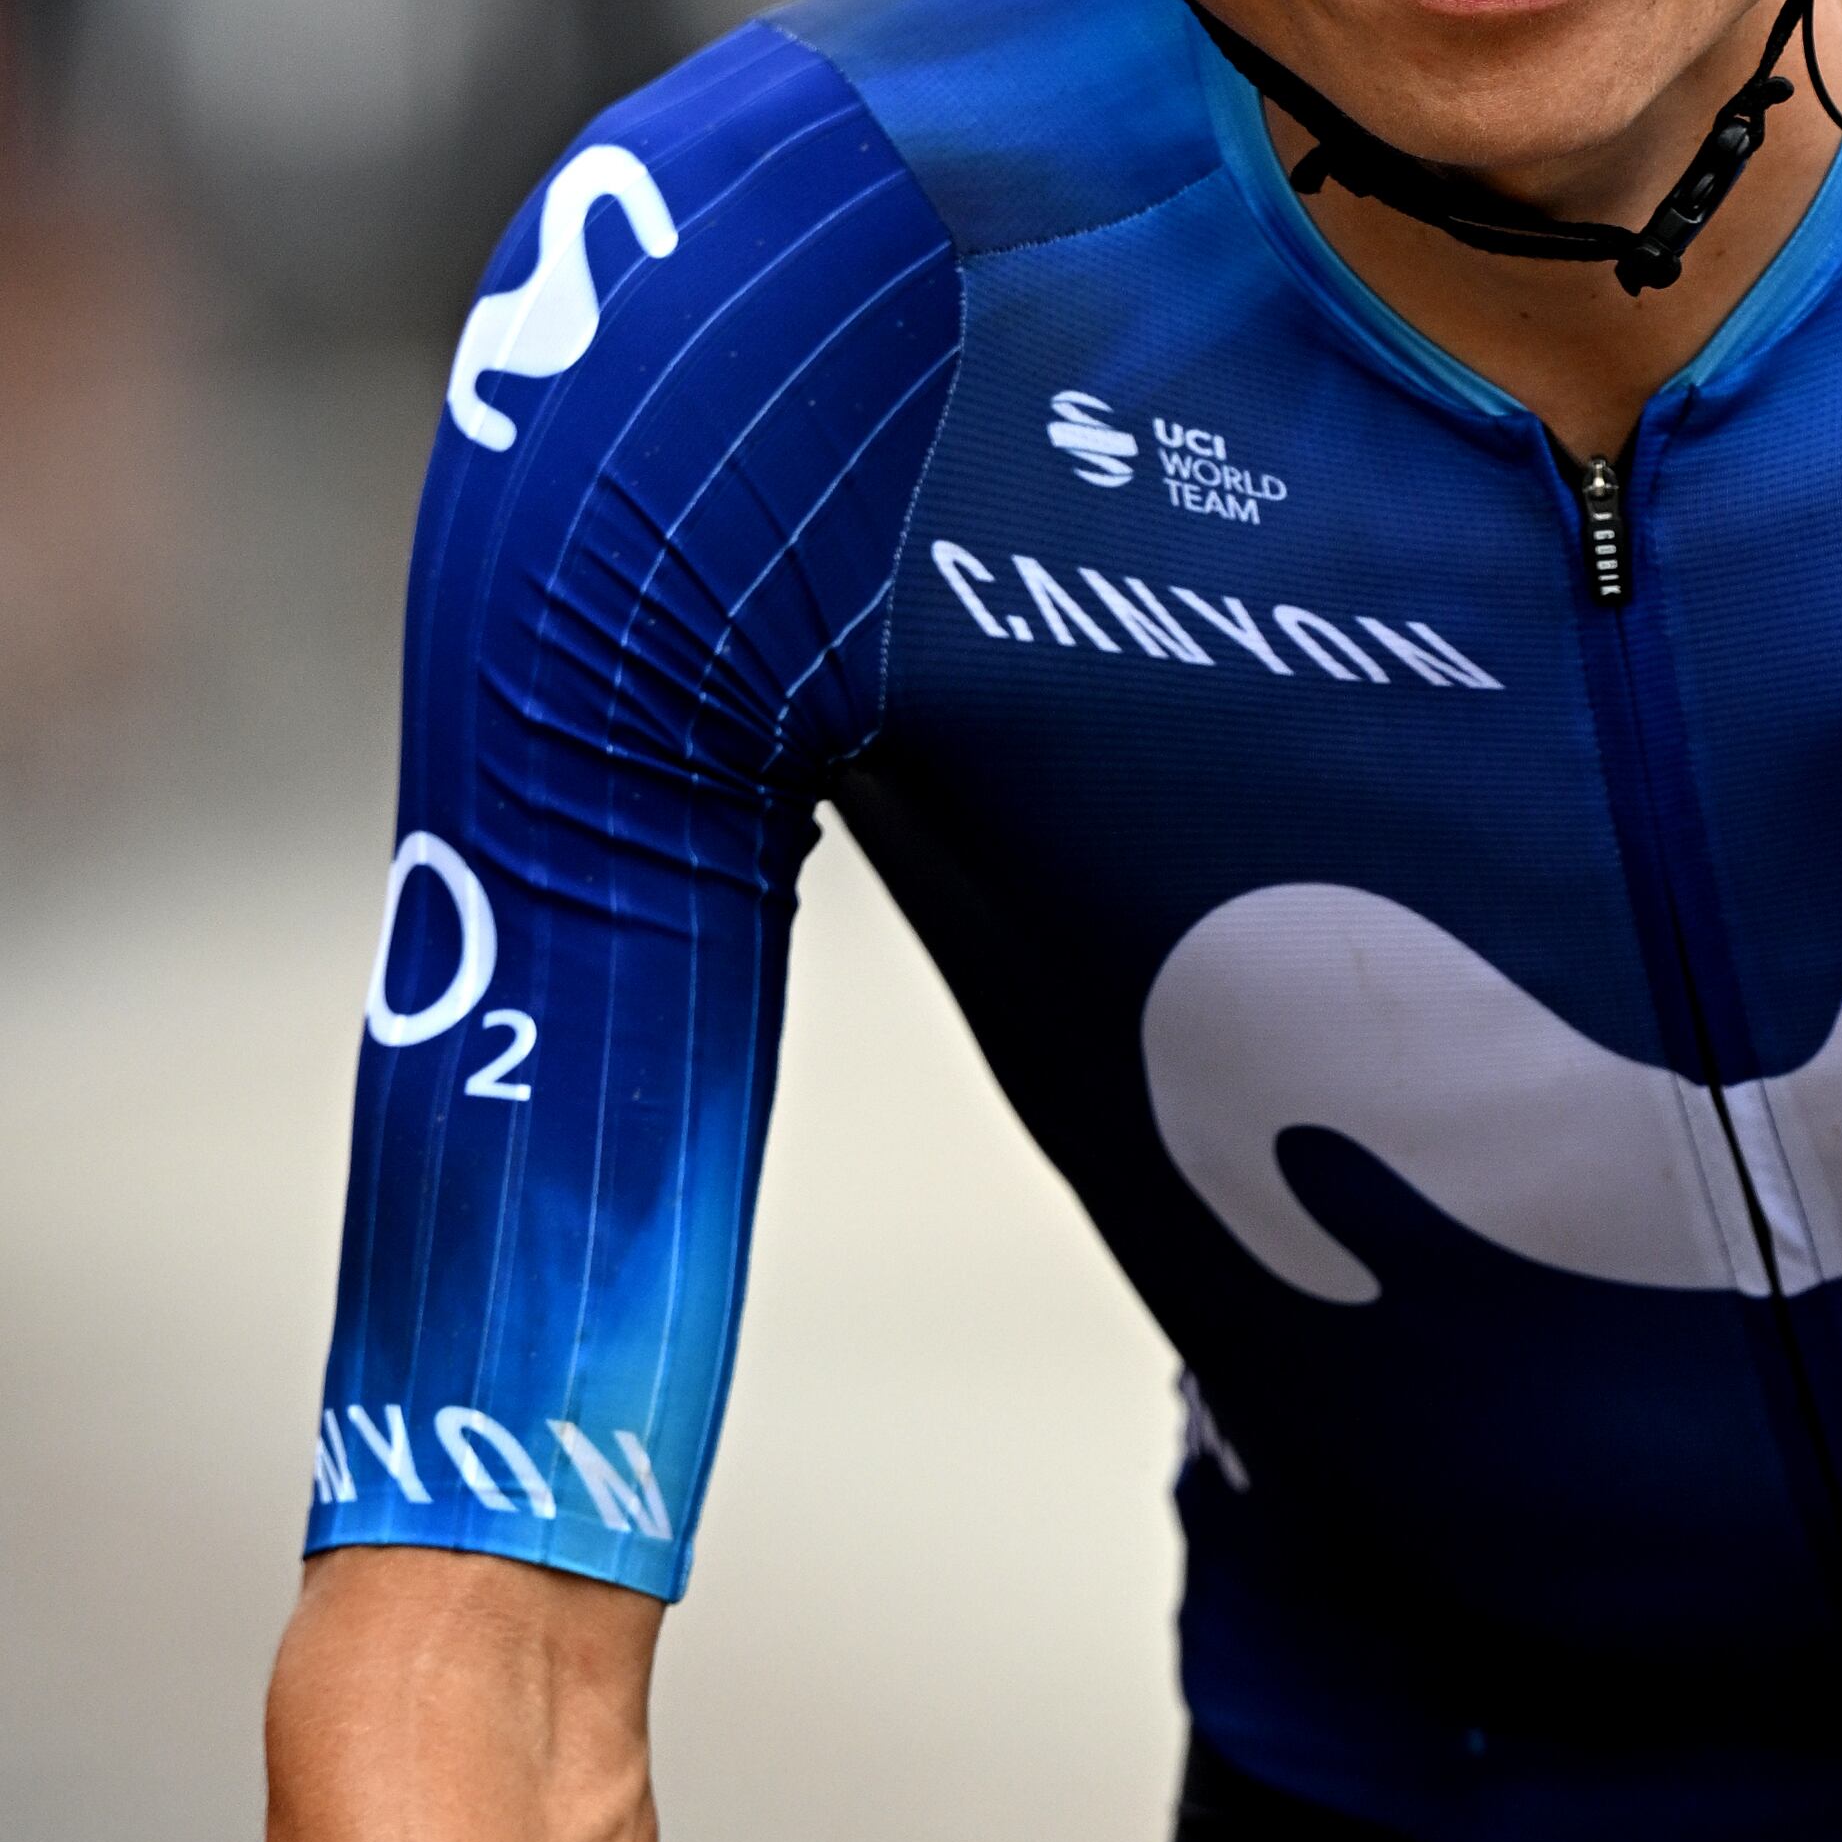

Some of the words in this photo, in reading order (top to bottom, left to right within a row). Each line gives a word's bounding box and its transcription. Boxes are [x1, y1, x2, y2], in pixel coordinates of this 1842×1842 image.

[1153, 417, 1227, 461] UCI
[1158, 448, 1288, 501] WORLD
[1163, 477, 1261, 525] TEAM
[931, 539, 1505, 690] CANYON
[314, 1404, 674, 1540] NYON
